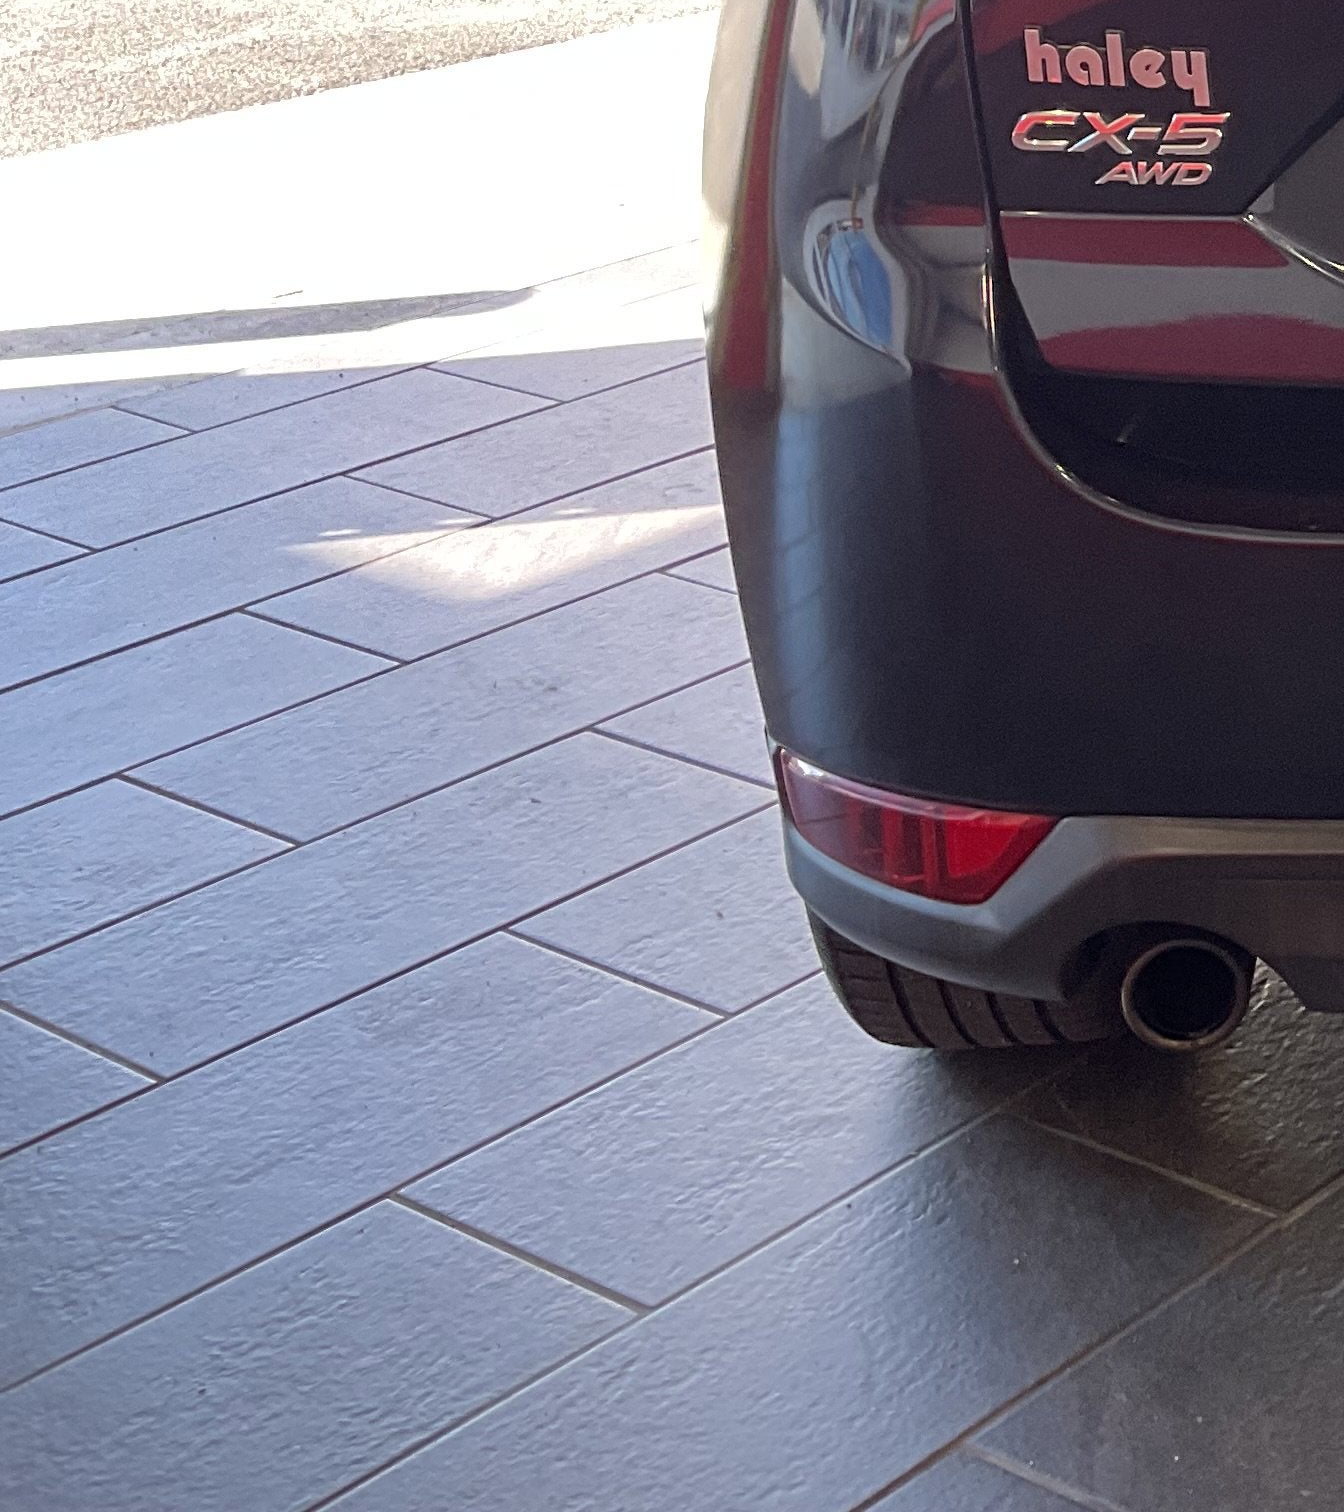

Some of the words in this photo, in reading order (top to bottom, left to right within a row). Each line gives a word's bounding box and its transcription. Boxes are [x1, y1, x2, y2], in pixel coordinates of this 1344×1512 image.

[1023, 25, 1211, 108] haley
[1011, 110, 1231, 156] CX-5
[1095, 161, 1213, 186] AWD
